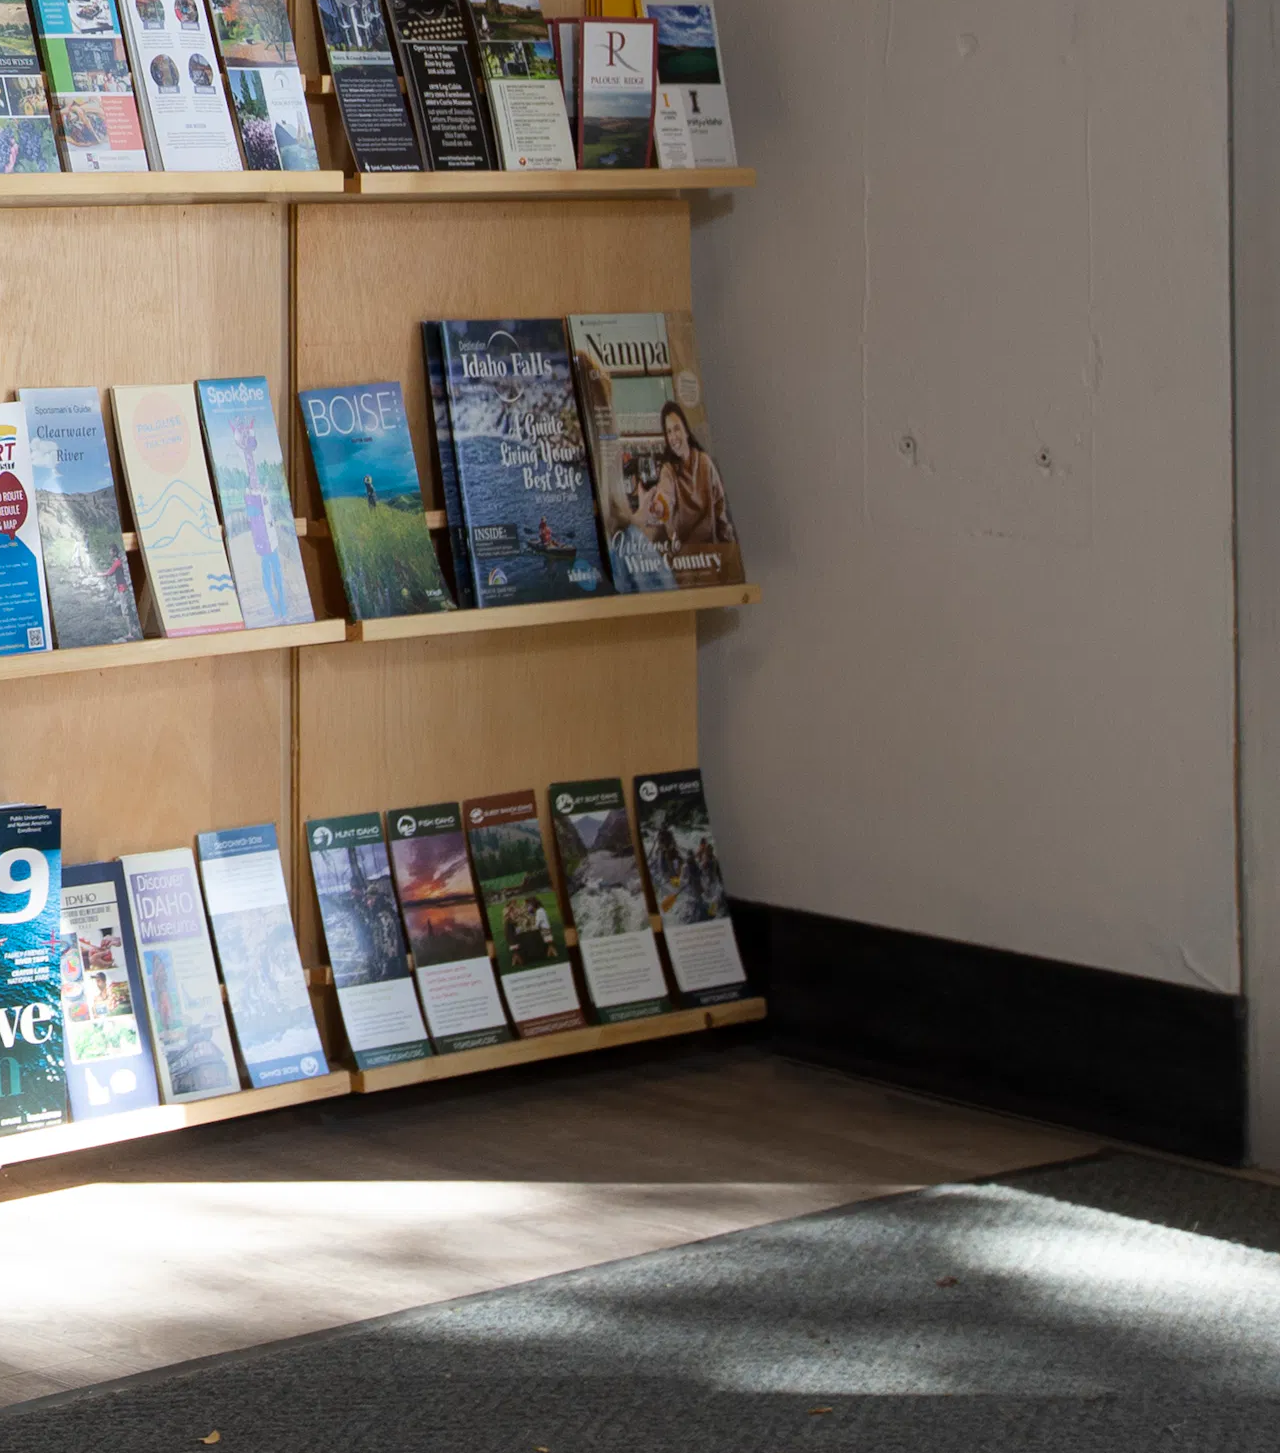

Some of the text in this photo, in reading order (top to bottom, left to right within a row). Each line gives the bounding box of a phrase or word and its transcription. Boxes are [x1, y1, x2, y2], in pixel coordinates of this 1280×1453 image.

[585, 333, 668, 369] Nampa
[462, 352, 552, 378] Idaho Falls
[308, 391, 395, 437] BOISE
[36, 425, 97, 441] Clearwater
[56, 448, 85, 463] River
